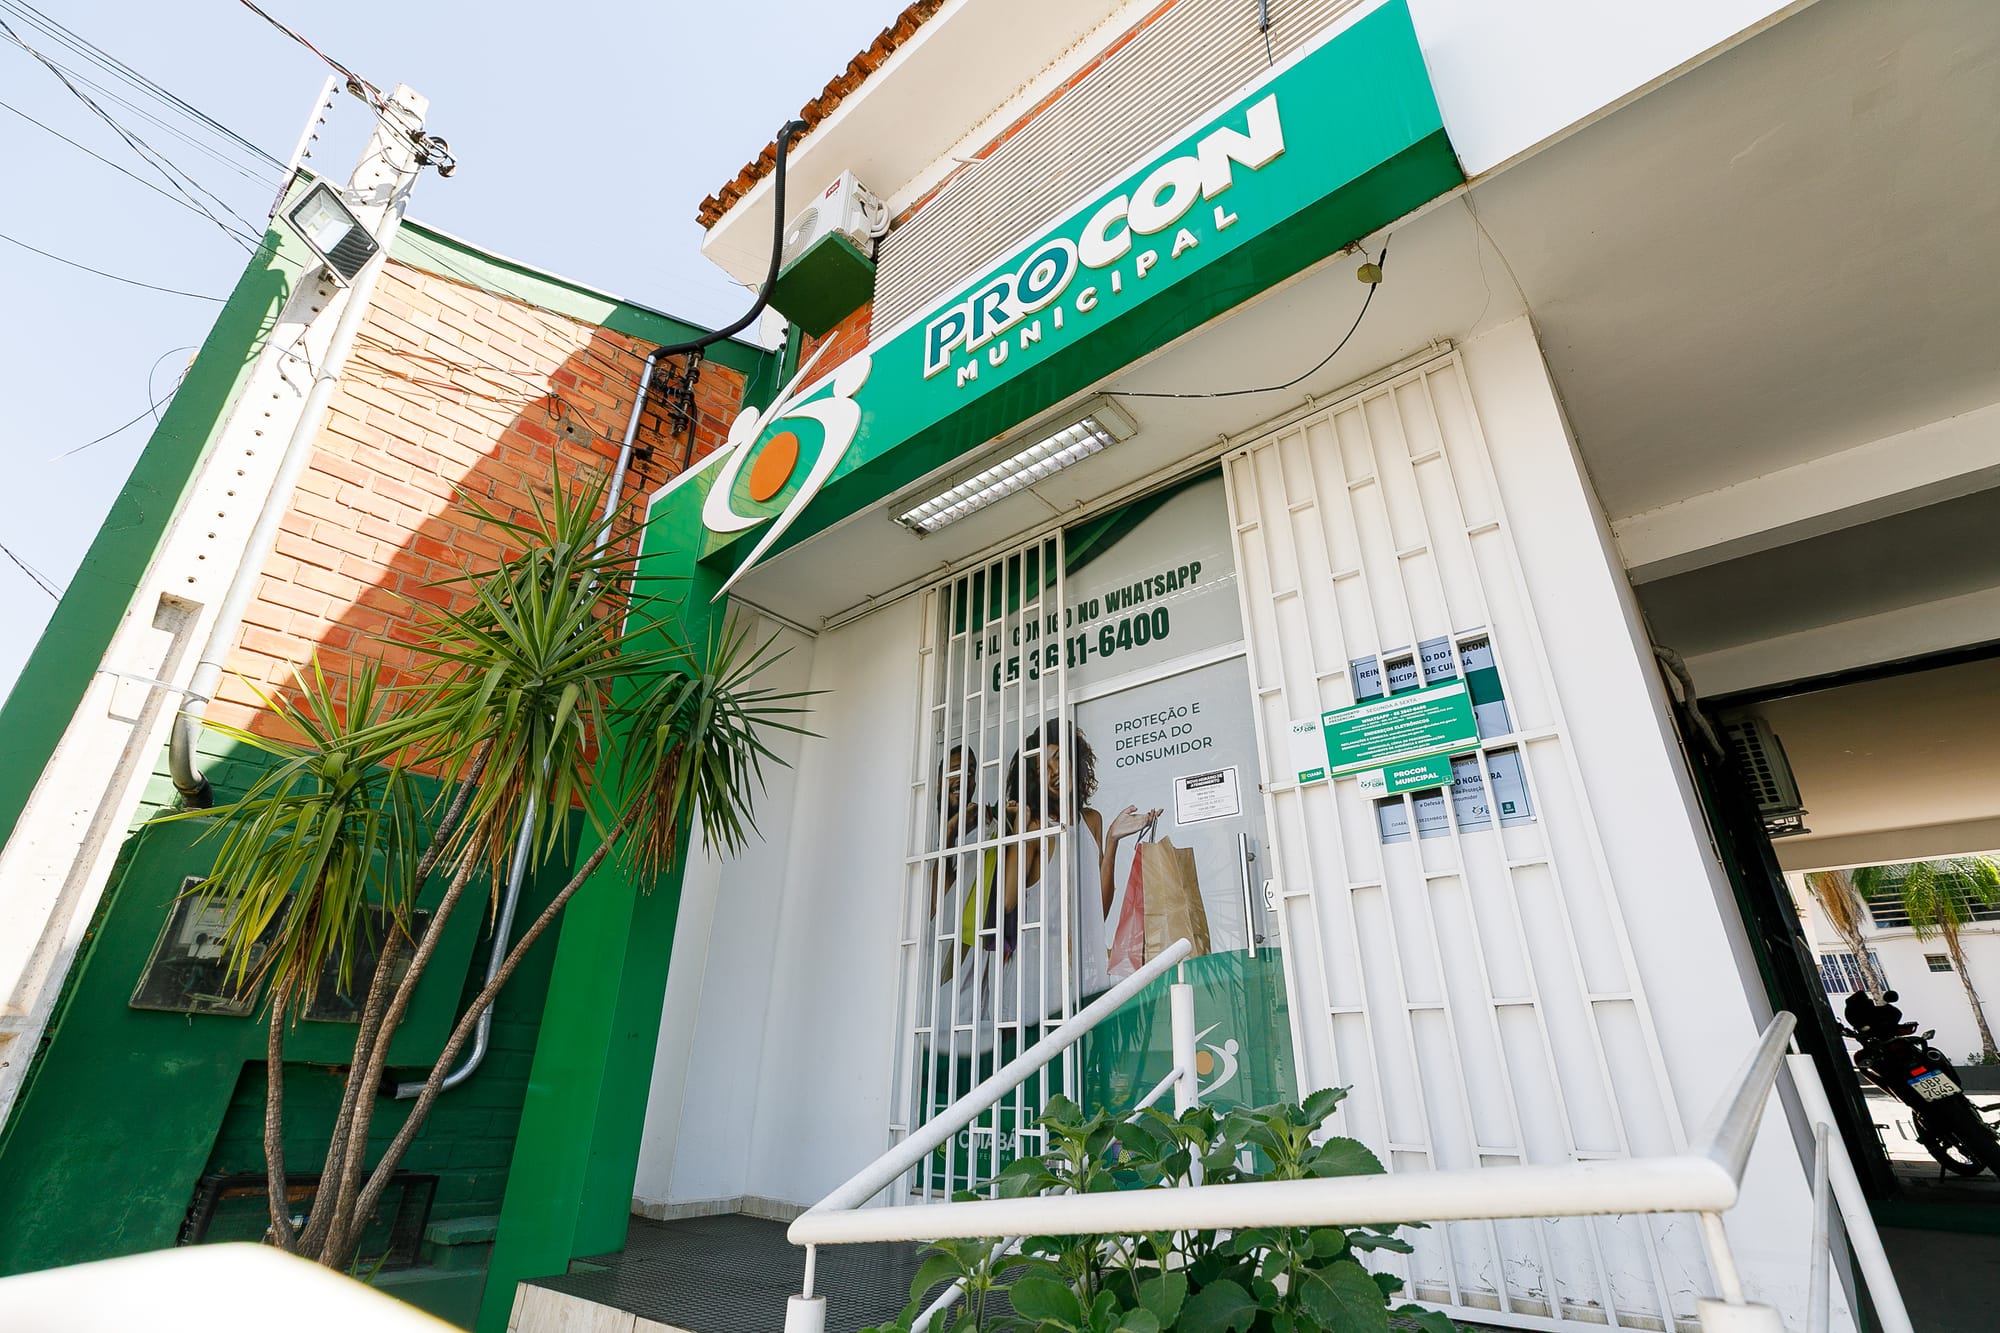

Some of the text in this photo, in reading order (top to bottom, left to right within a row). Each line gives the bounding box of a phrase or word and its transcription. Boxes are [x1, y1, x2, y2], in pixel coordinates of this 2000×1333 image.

[923, 92, 1285, 380] PROCON
[957, 205, 1239, 388] MUNICIPAL
[1078, 598, 1099, 624] NO
[1105, 561, 1201, 614] WHATSAPP
[1434, 652, 1446, 660] DO
[1424, 667, 1436, 676] DE
[1115, 702, 1200, 734] PROTEÇÃO E
[1115, 723, 1192, 752] DEFESA DO
[1116, 736, 1213, 768] CONSUMIDOR
[1394, 767, 1427, 779] PROCON
[1395, 773, 1439, 786] MUNICIPAL
